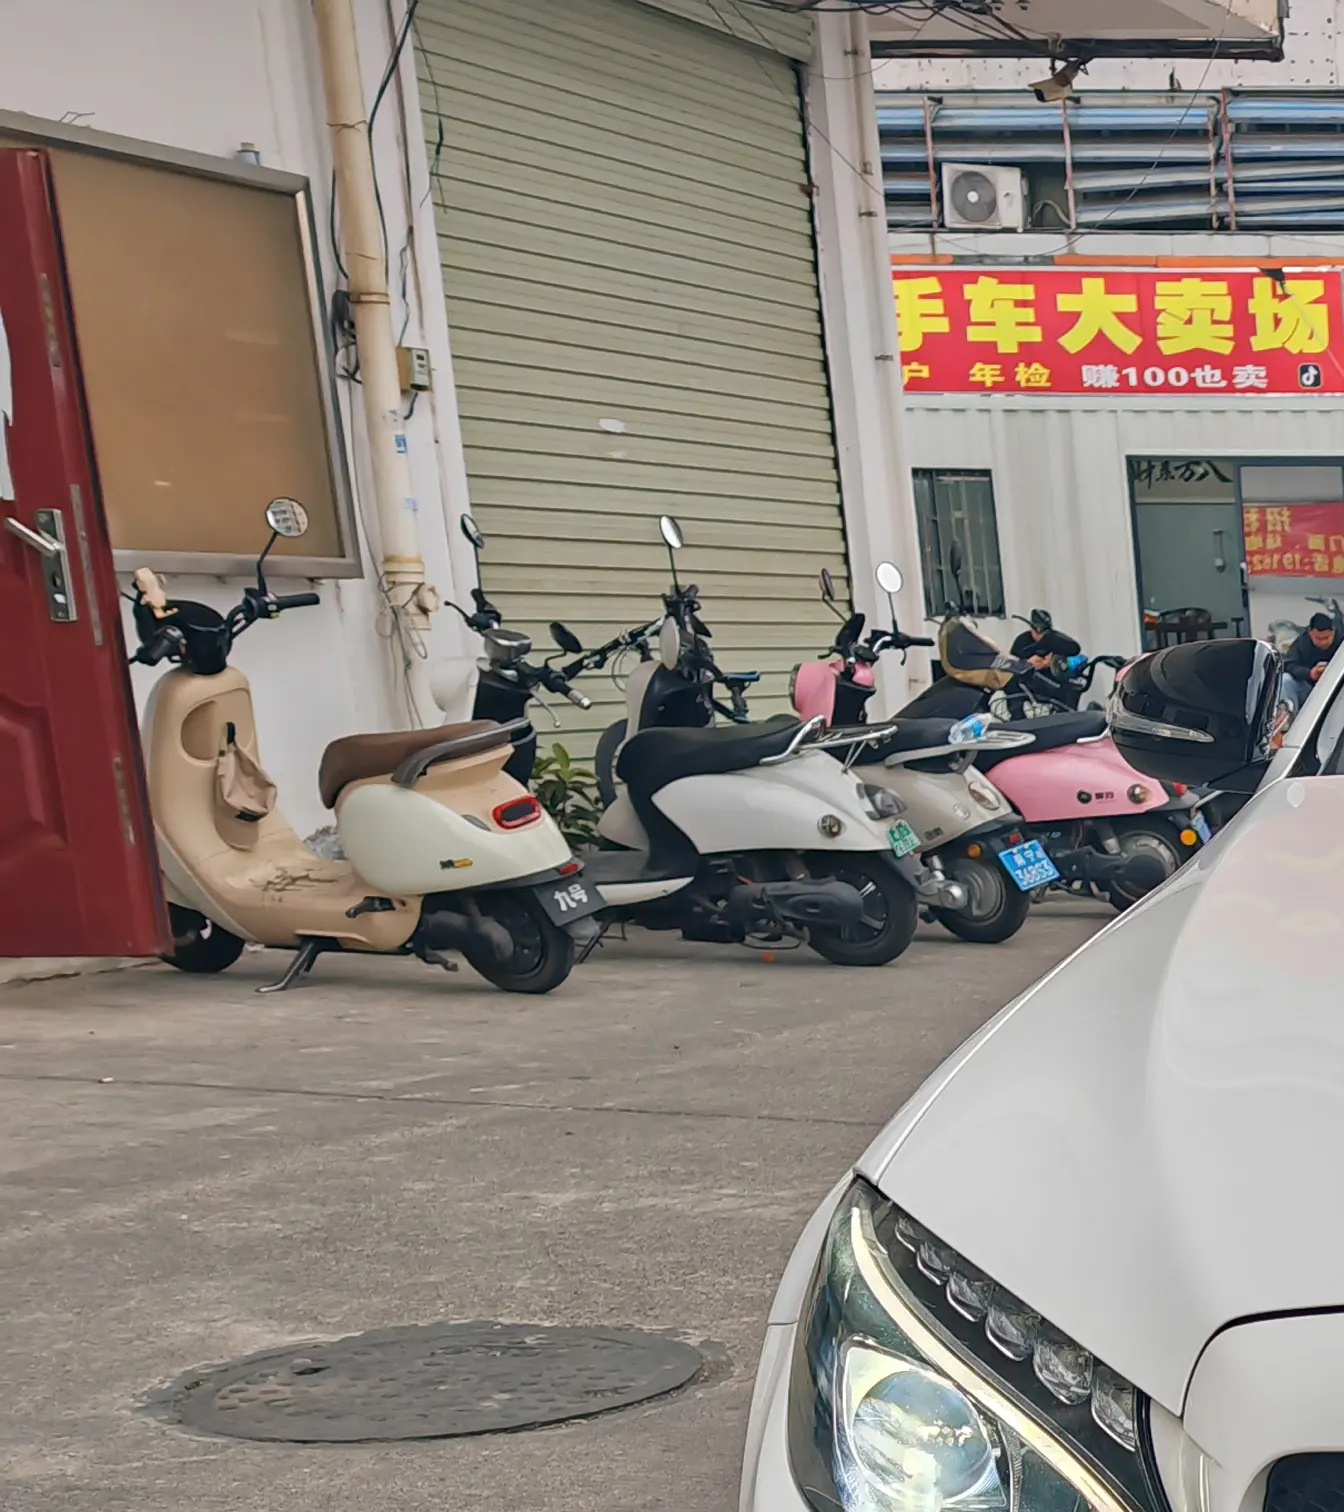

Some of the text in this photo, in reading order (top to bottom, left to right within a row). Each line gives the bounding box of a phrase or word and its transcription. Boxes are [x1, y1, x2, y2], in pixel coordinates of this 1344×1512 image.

[893, 276, 1330, 355] 手车大卖场
[969, 362, 1052, 388] 年检
[1081, 364, 1269, 389] 赚100也卖
[553, 883, 588, 912] 九号
